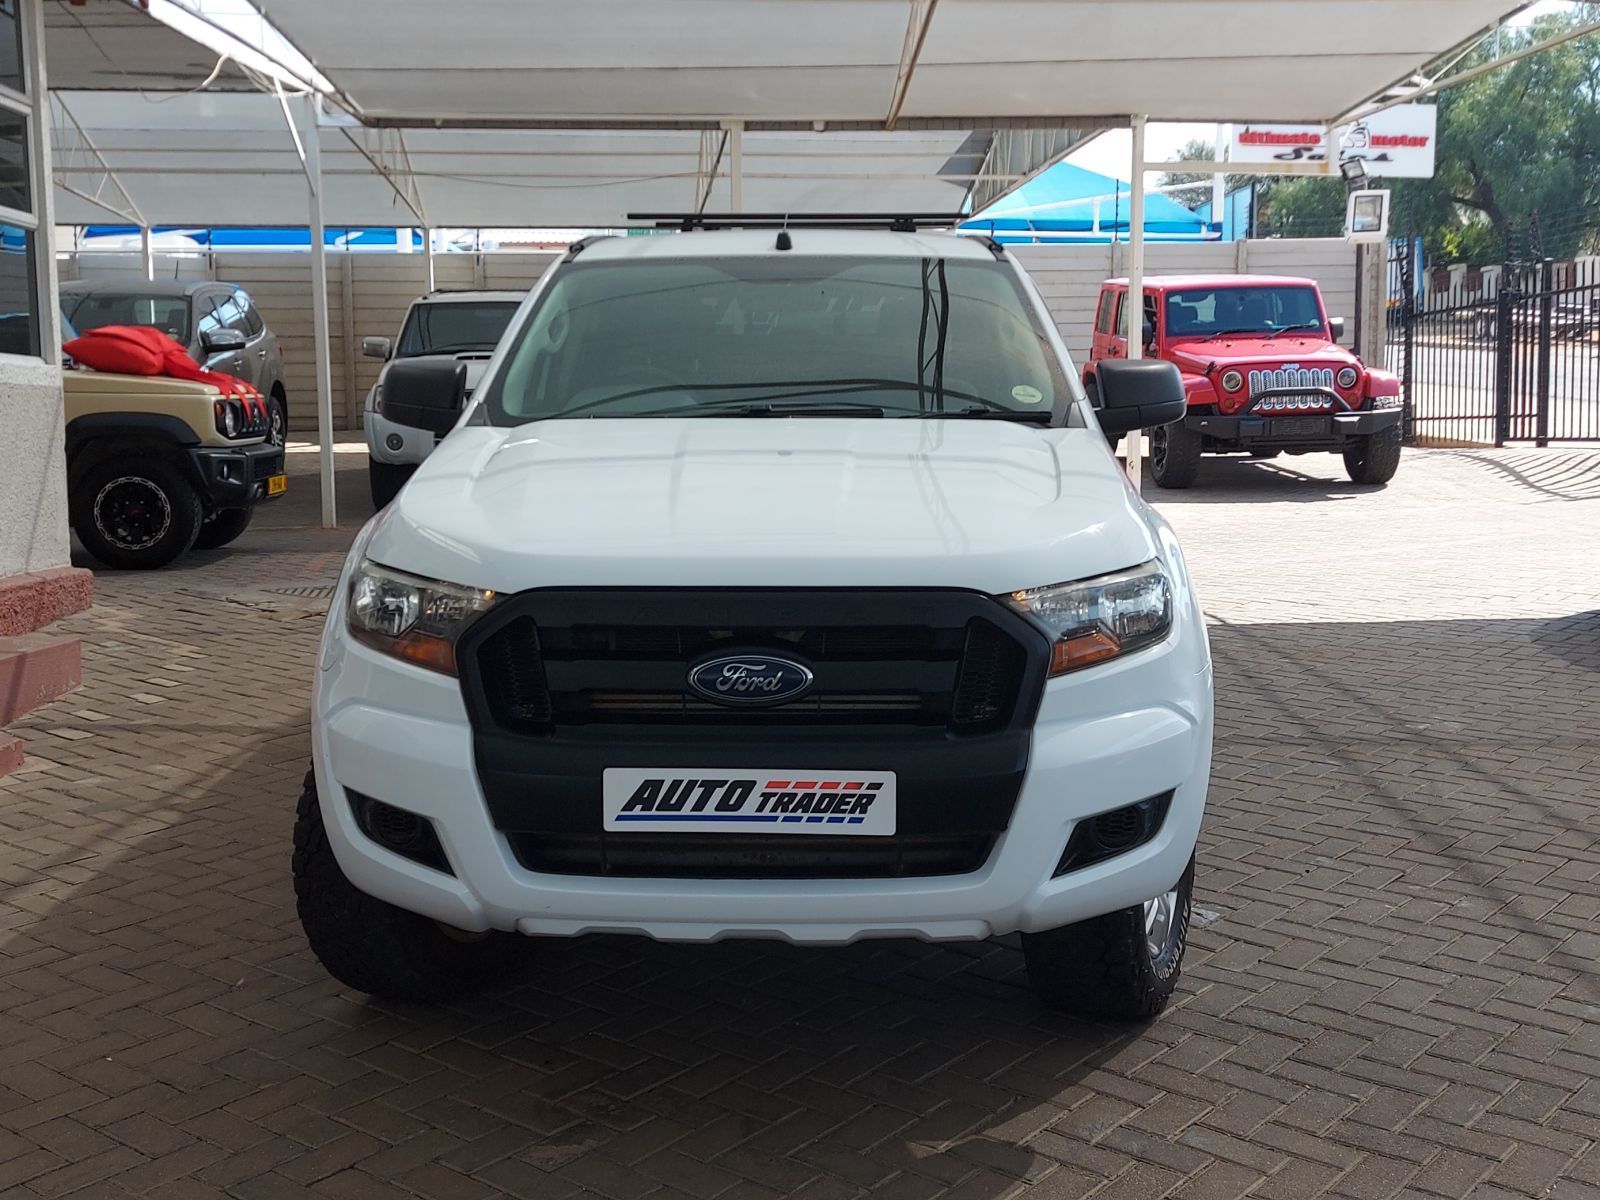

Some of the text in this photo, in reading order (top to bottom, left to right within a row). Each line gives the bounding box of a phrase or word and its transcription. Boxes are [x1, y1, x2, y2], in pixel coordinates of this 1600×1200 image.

[1371, 134, 1430, 147] motor
[716, 663, 783, 691] Ford
[620, 779, 876, 814] AUTO TRADER
